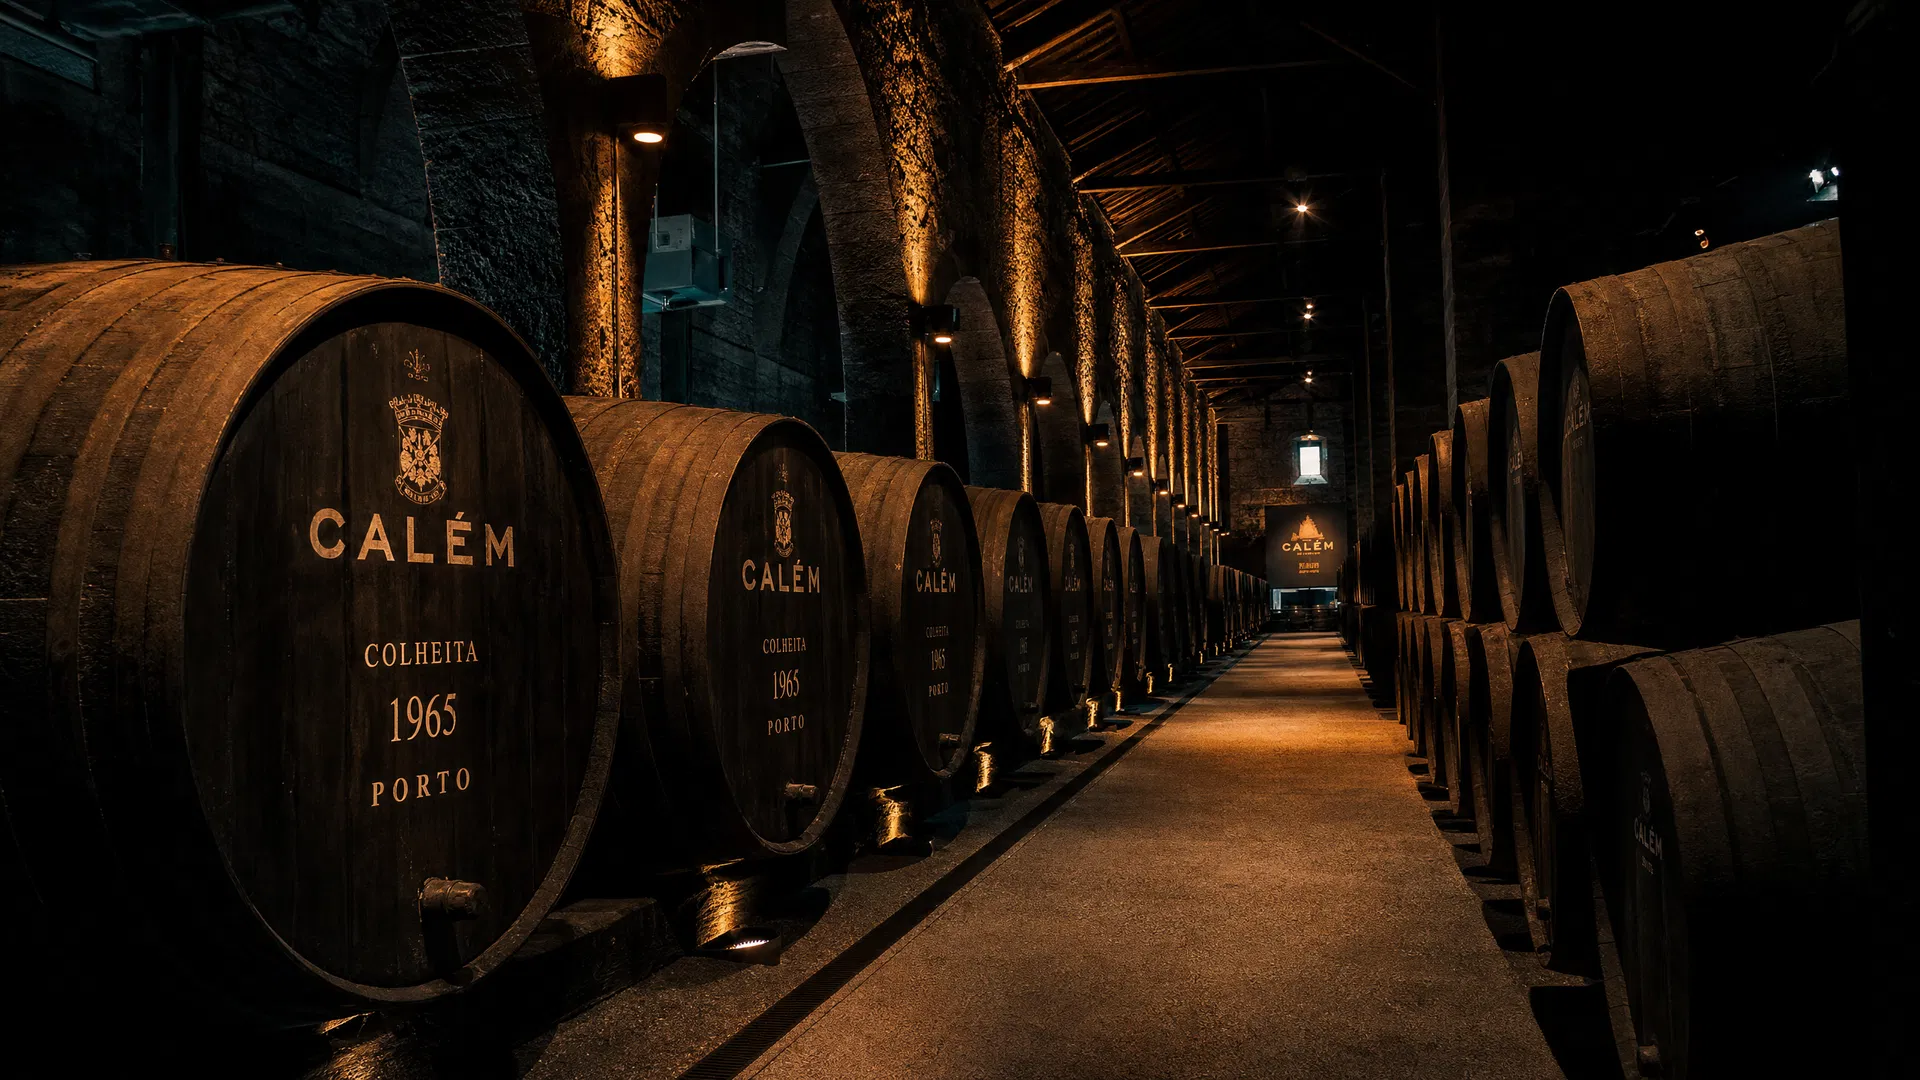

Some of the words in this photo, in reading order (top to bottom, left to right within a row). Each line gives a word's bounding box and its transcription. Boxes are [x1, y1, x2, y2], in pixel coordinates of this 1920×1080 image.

[309, 507, 515, 568] CALÉM
[1282, 540, 1335, 552] CALÉM
[741, 559, 820, 593] CALÉM
[915, 568, 957, 593] CALÉM
[364, 639, 480, 669] COLHEITA
[762, 637, 807, 655] COLHEITA
[931, 648, 947, 672] 1965
[772, 668, 801, 700] 1965
[928, 682, 949, 698] PORTO
[390, 692, 458, 743] 1965
[767, 713, 806, 736] PORTO
[371, 766, 472, 808] PORTO
